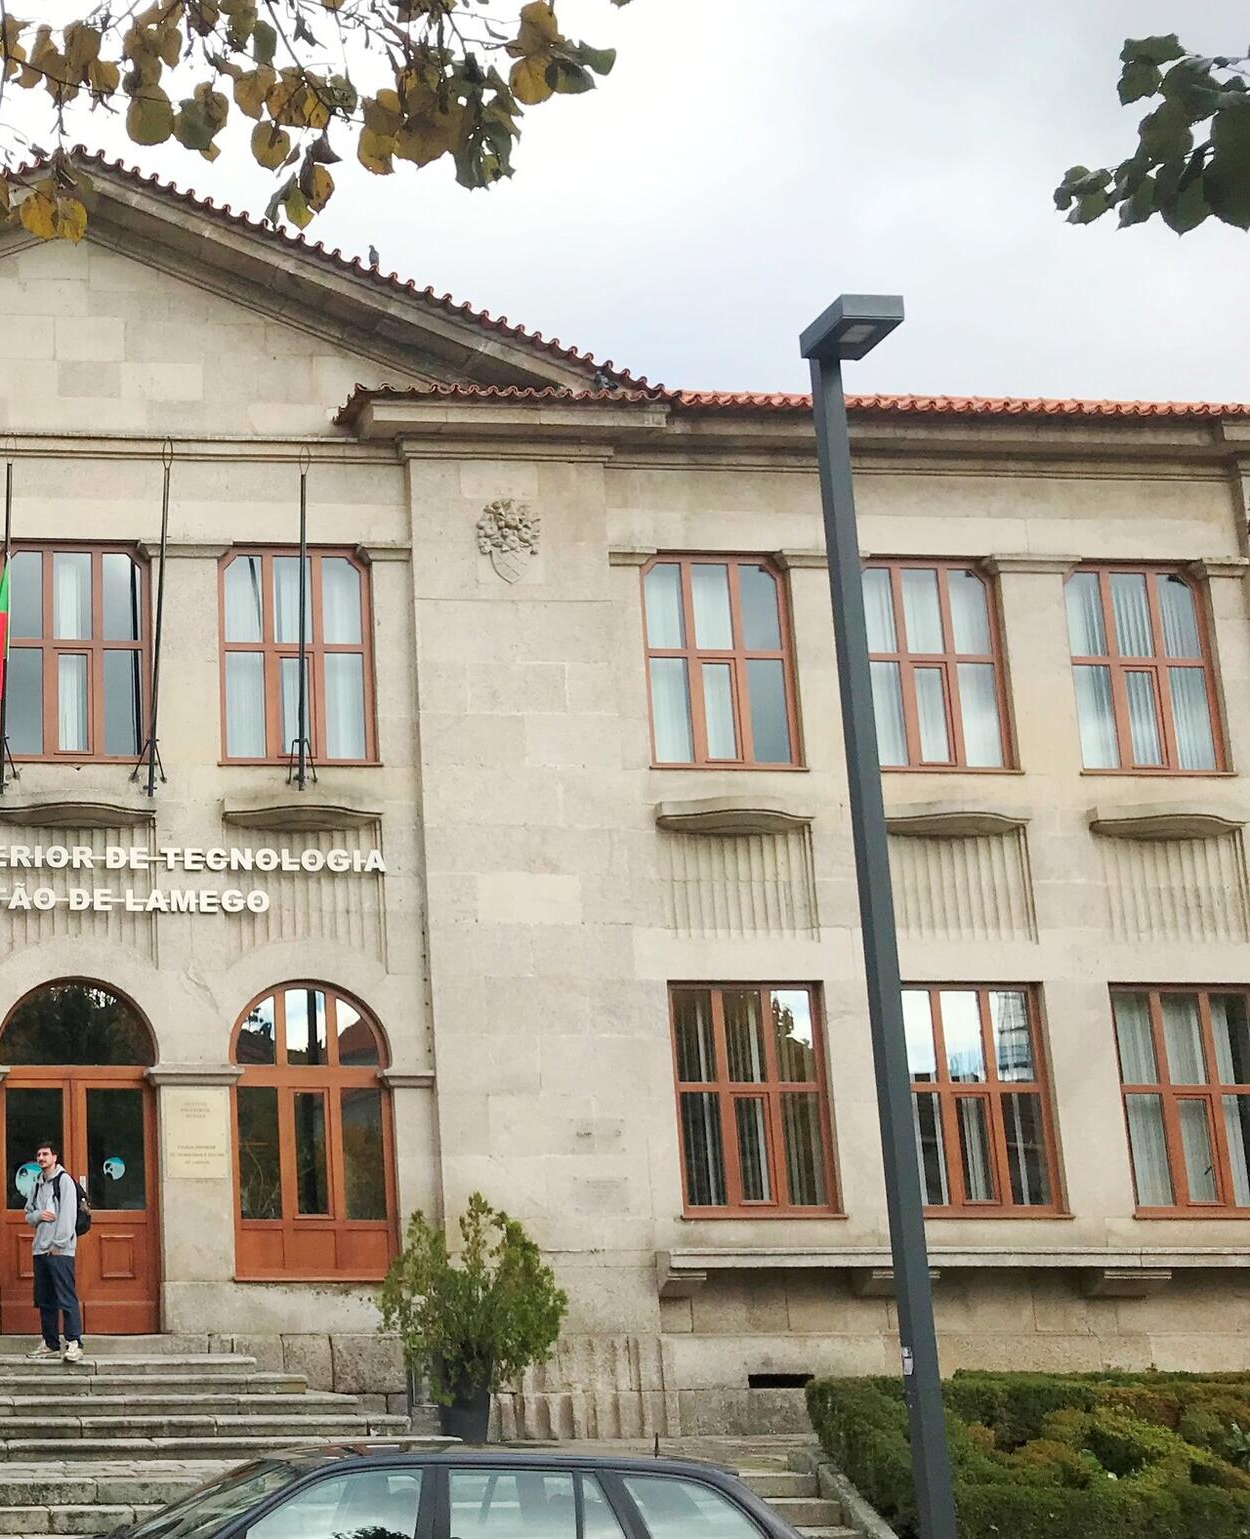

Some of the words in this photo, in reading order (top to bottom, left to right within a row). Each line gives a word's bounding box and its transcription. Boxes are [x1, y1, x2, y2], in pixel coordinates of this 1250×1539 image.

[106, 846, 149, 869] DE
[160, 847, 387, 873] TECNOLOGIA
[69, 888, 112, 911] DE
[125, 888, 270, 913] LAMEGO
